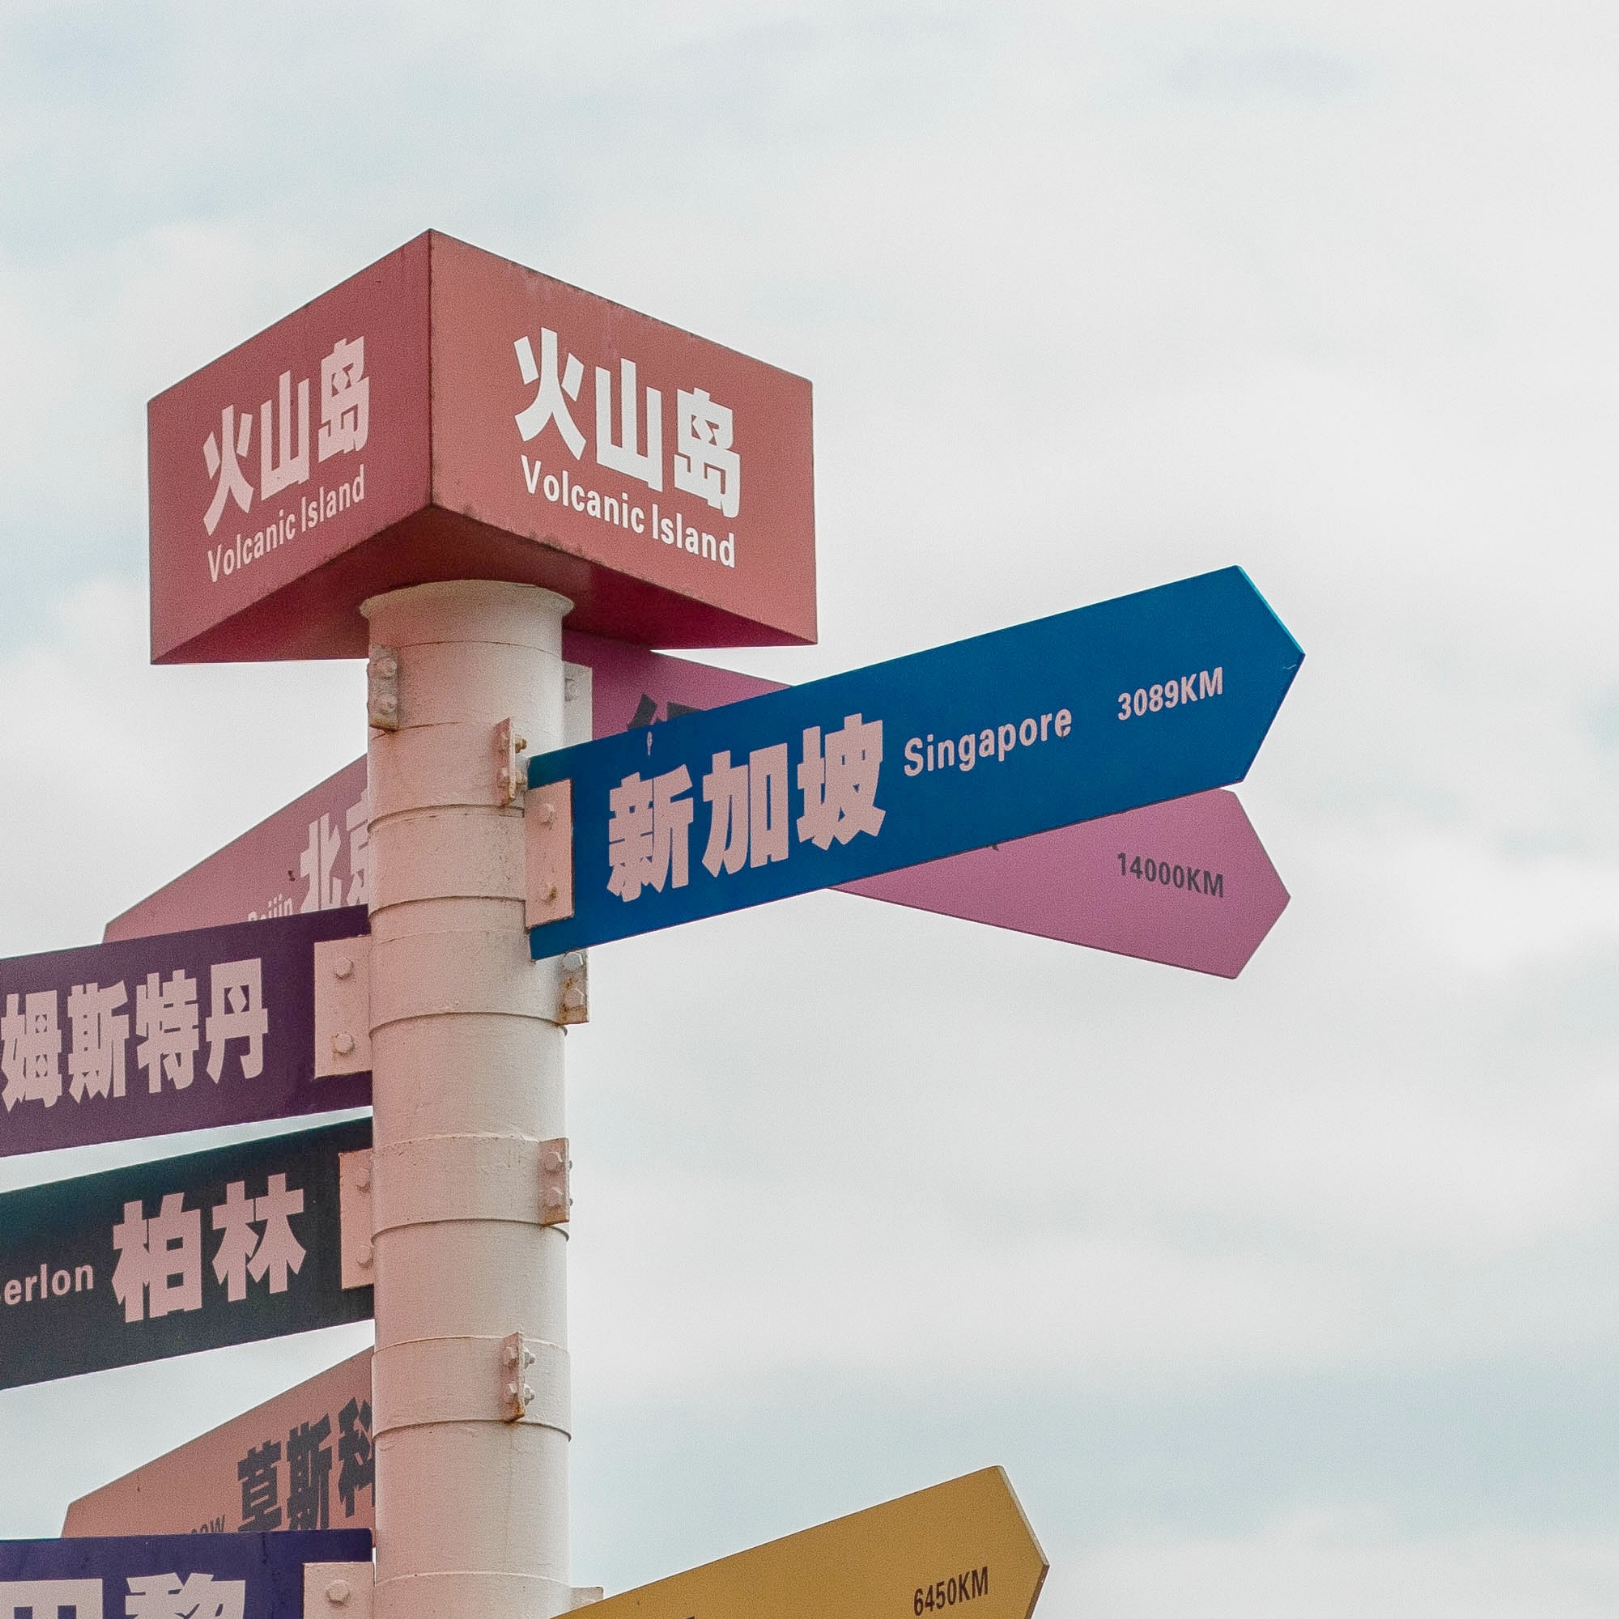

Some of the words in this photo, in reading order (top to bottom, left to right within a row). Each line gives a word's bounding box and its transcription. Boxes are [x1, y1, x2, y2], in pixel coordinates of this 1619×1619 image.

[202, 335, 370, 536] 火山岛
[514, 327, 740, 518] 火山岛
[207, 510, 296, 583] Volcanic
[301, 464, 365, 533] Island
[521, 455, 645, 534] Volcanic
[652, 510, 735, 568] Island
[606, 713, 886, 903] 新加坡
[903, 708, 1073, 778] Singapore
[1118, 667, 1224, 722] 3089KM
[1116, 852, 1225, 898] 14000KM
[111, 1172, 306, 1324] 柏林
[912, 1566, 990, 1617] 6450KM
